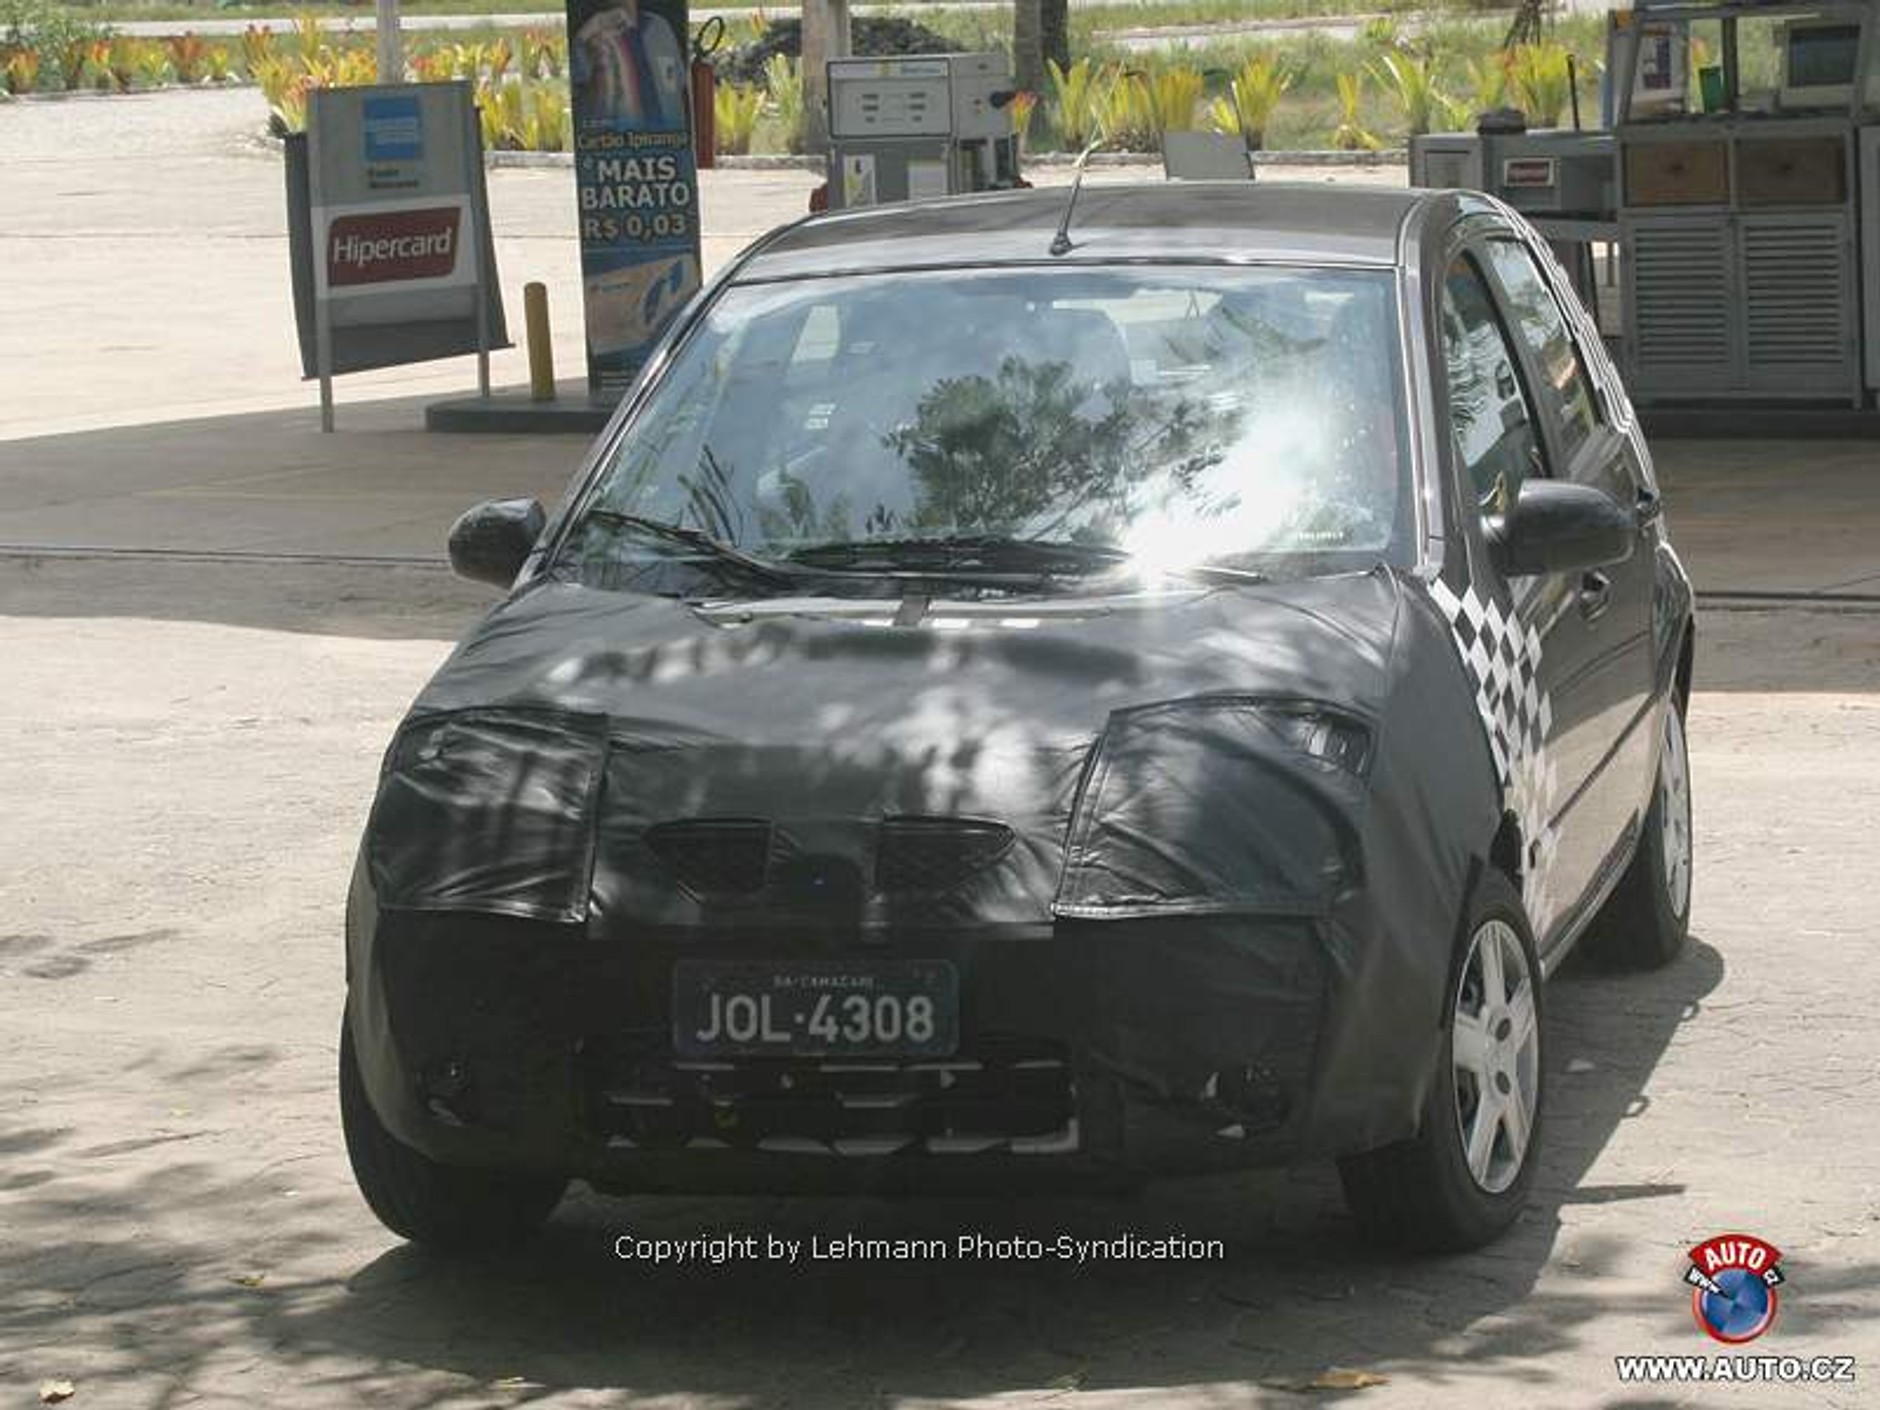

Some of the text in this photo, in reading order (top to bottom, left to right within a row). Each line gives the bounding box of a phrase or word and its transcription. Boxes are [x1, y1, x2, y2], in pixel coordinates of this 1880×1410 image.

[598, 156, 677, 182] MAIS
[582, 182, 689, 209] BARATO
[584, 214, 686, 240] R$ 0,03
[333, 226, 452, 268] Hipercard
